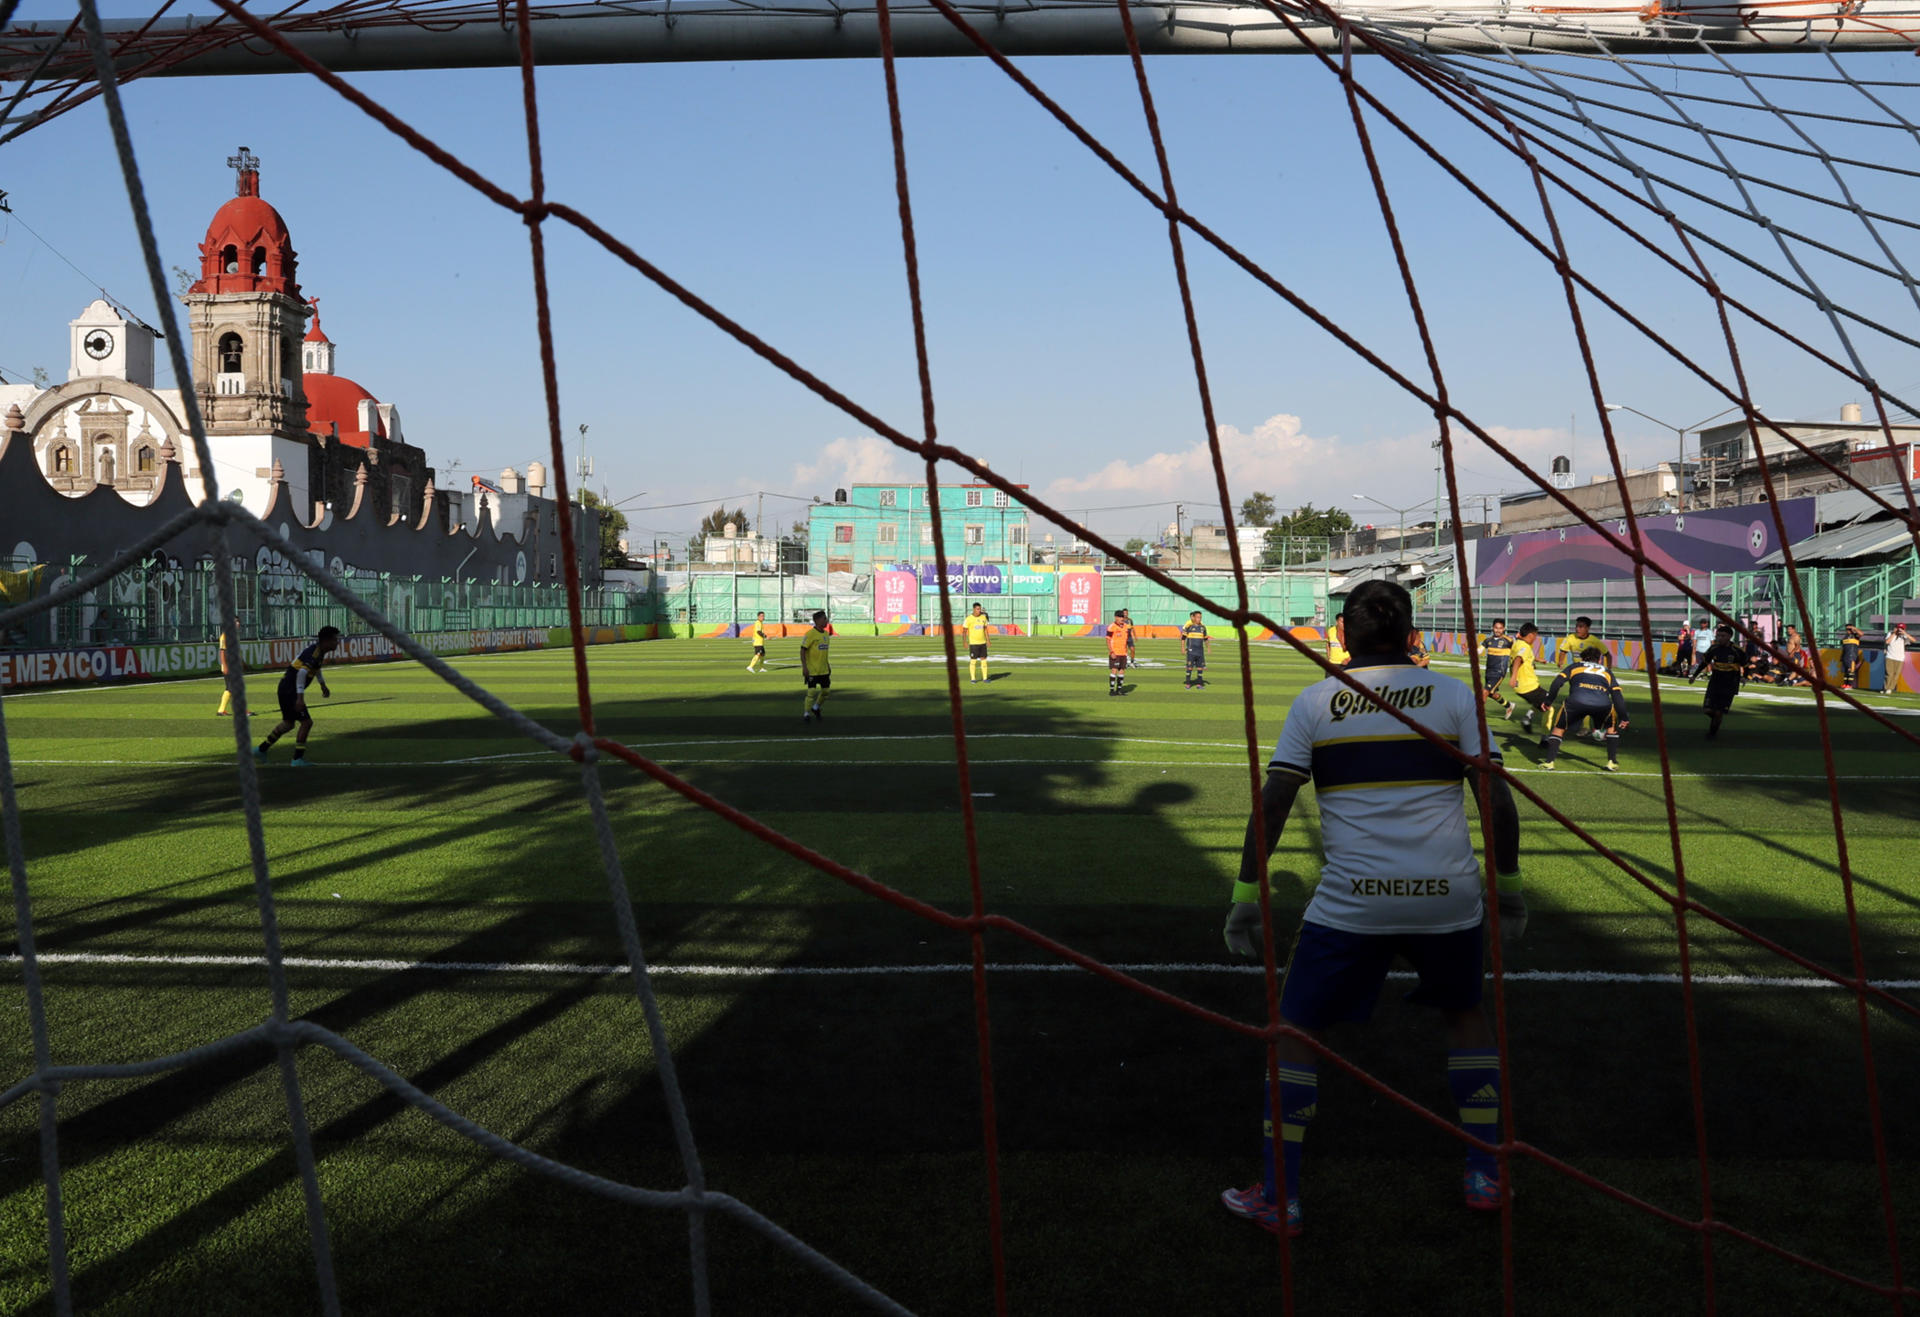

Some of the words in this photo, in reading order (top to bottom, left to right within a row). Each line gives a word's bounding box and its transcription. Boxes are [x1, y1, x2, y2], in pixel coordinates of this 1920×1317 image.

[933, 574, 1000, 584] DPORTIVO
[1002, 575, 1044, 584] TEPITO
[15, 650, 107, 683] MEXICO
[110, 649, 137, 676] LA
[140, 646, 182, 673] MAS
[184, 641, 272, 670] DEPTIVA
[273, 640, 292, 663] UN
[349, 637, 372, 658] QUE
[373, 635, 402, 655] MUEV
[1584, 661, 1606, 678] 22
